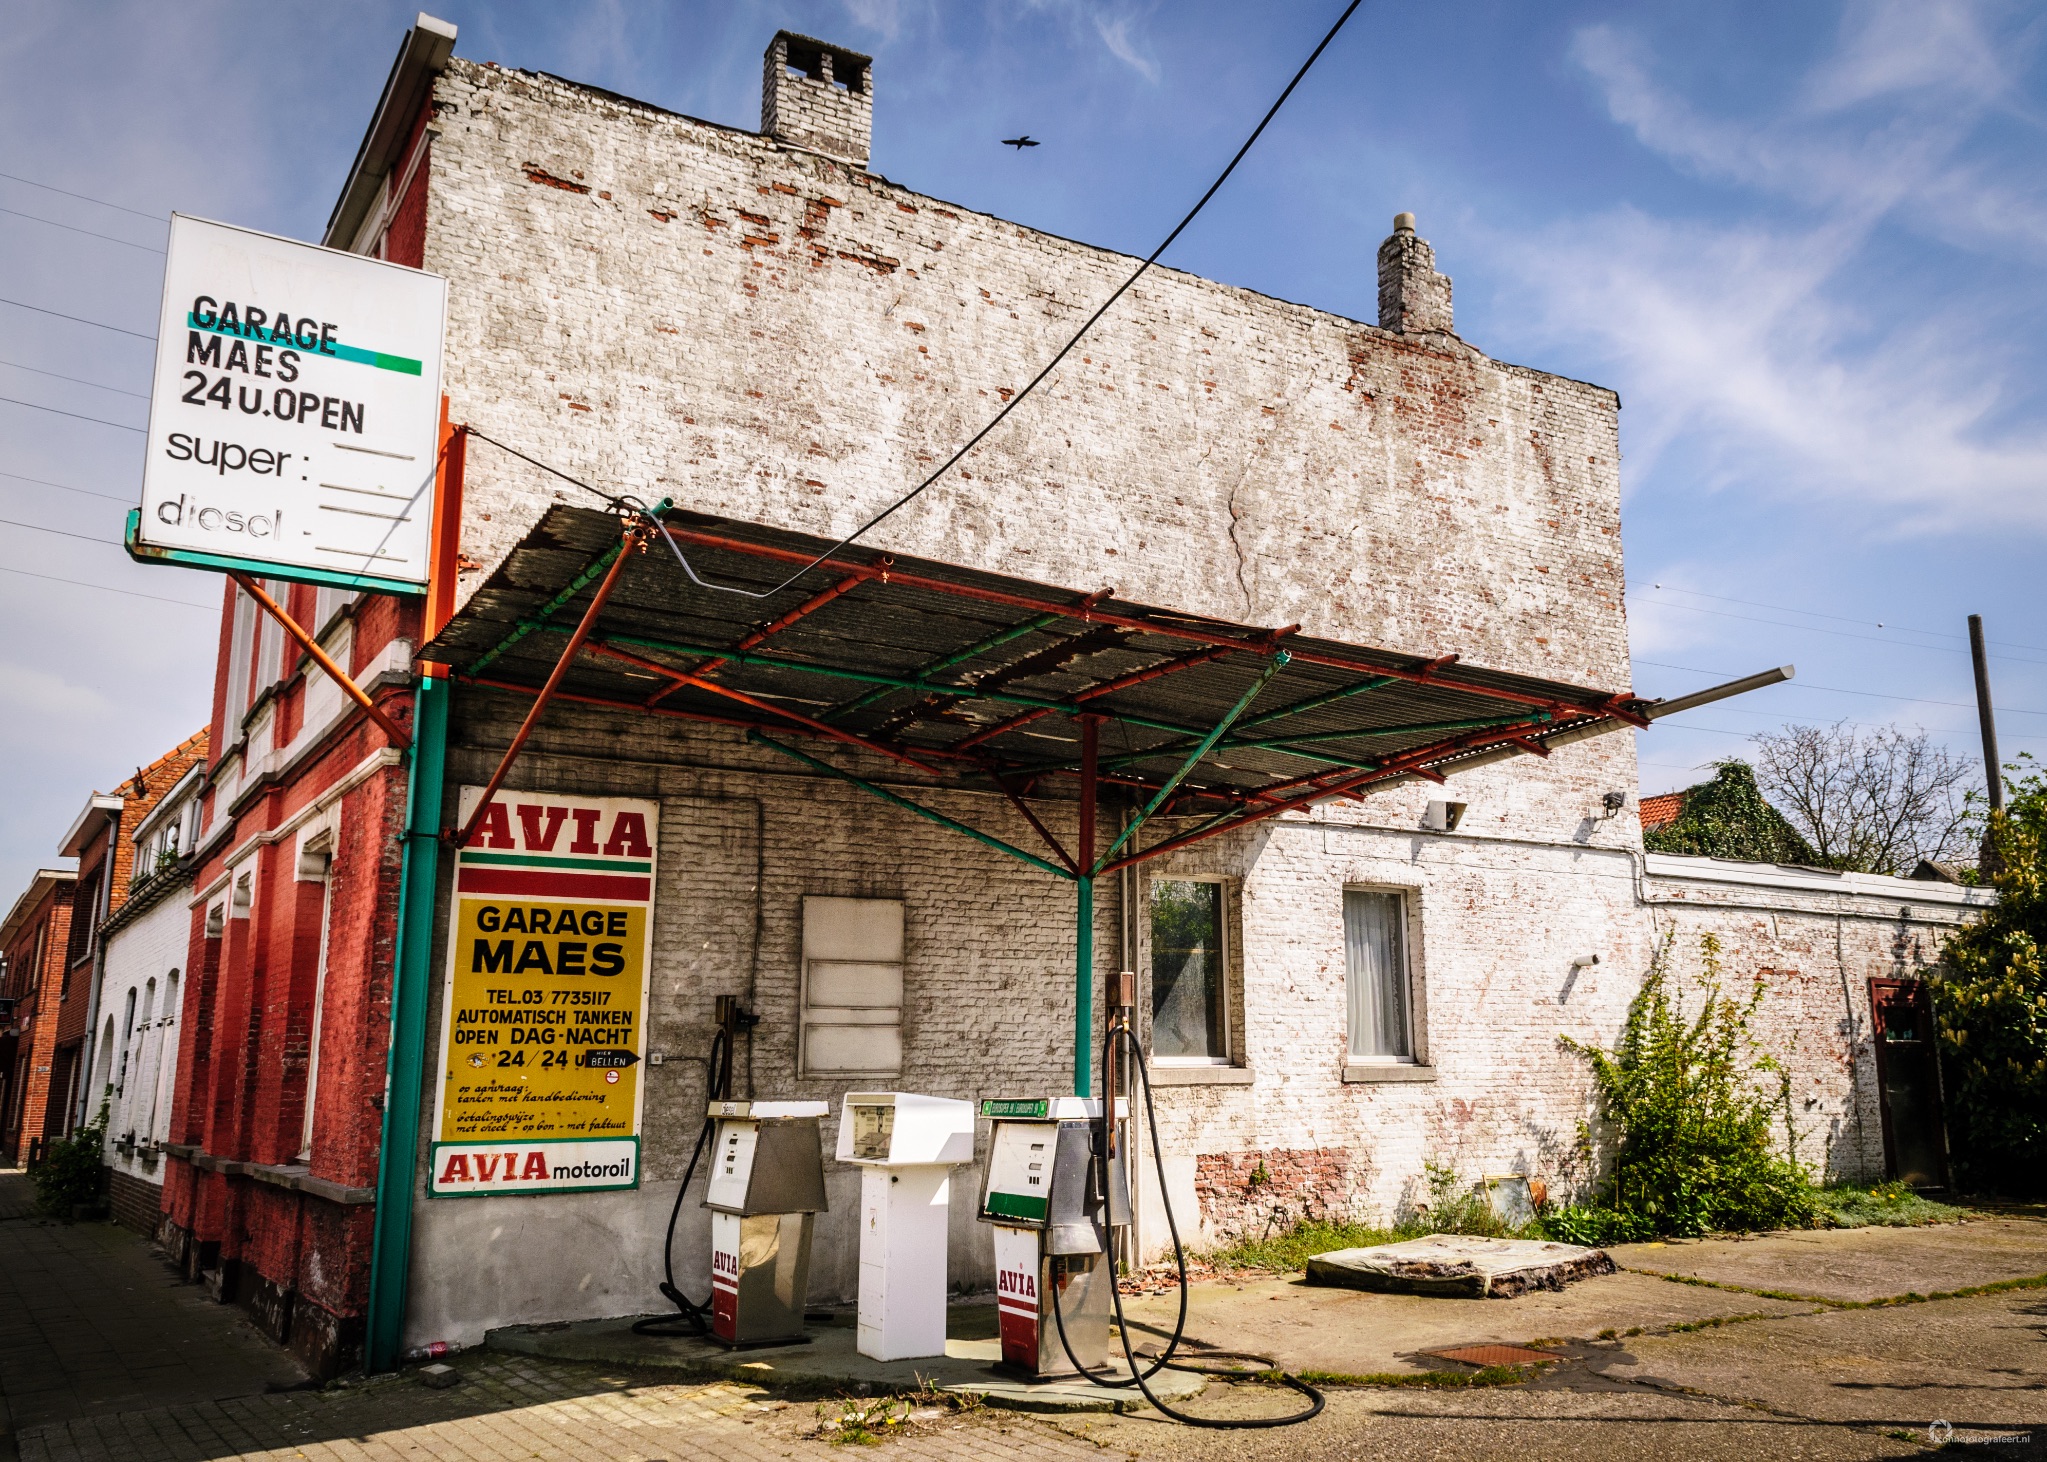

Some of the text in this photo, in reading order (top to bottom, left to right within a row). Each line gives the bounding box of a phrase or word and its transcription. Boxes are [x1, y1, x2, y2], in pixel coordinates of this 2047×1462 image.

[193, 296, 338, 355] GARAGE
[187, 331, 301, 382] MAES
[464, 801, 652, 858] AVIA
[477, 906, 628, 937] GARAGE
[472, 939, 625, 977] MAES
[457, 1009, 633, 1025] AUTOMATISCH TANKEN
[455, 1029, 499, 1045] OPEN
[591, 1057, 626, 1066] BELLEN
[457, 1093, 493, 1103] tanken
[459, 1086, 470, 1095] op
[456, 1124, 477, 1133] met
[522, 1125, 534, 1134] op
[567, 1121, 585, 1131] met
[438, 1151, 630, 1184] AVIA motoroil
[714, 1250, 738, 1276] AVIA
[998, 1269, 1036, 1297] AVIA
